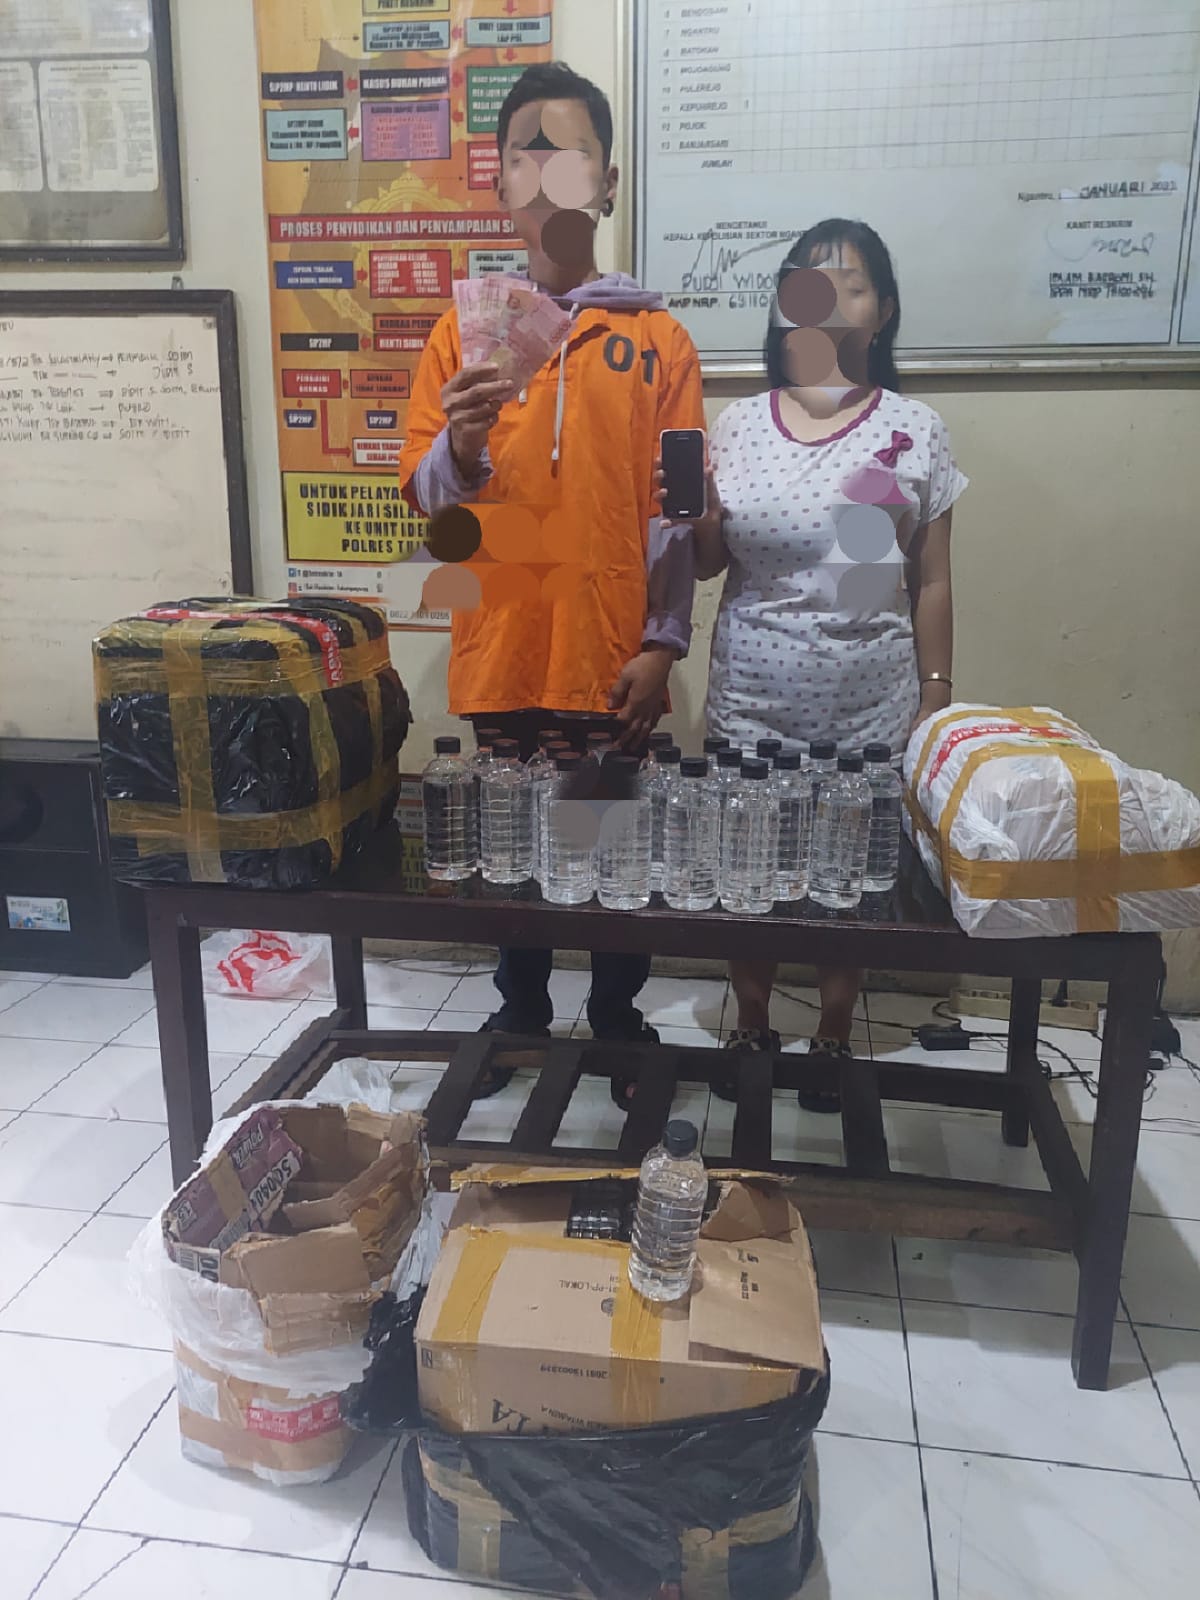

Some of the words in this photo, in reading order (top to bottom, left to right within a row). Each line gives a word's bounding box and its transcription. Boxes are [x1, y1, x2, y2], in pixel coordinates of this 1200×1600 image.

[1079, 181, 1145, 199] JANUARI
[280, 221, 323, 238] PROSES
[326, 219, 393, 237] PENYIDIKAN
[396, 219, 418, 234] DAN
[300, 483, 347, 499] UNTUK
[351, 486, 400, 500] PELAYA
[307, 501, 348, 517] SIDIK
[350, 503, 379, 518] JARI
[382, 503, 420, 519] SILA
[345, 521, 361, 535] KE
[364, 522, 397, 537] UNIT
[341, 538, 393, 553] POLRES
